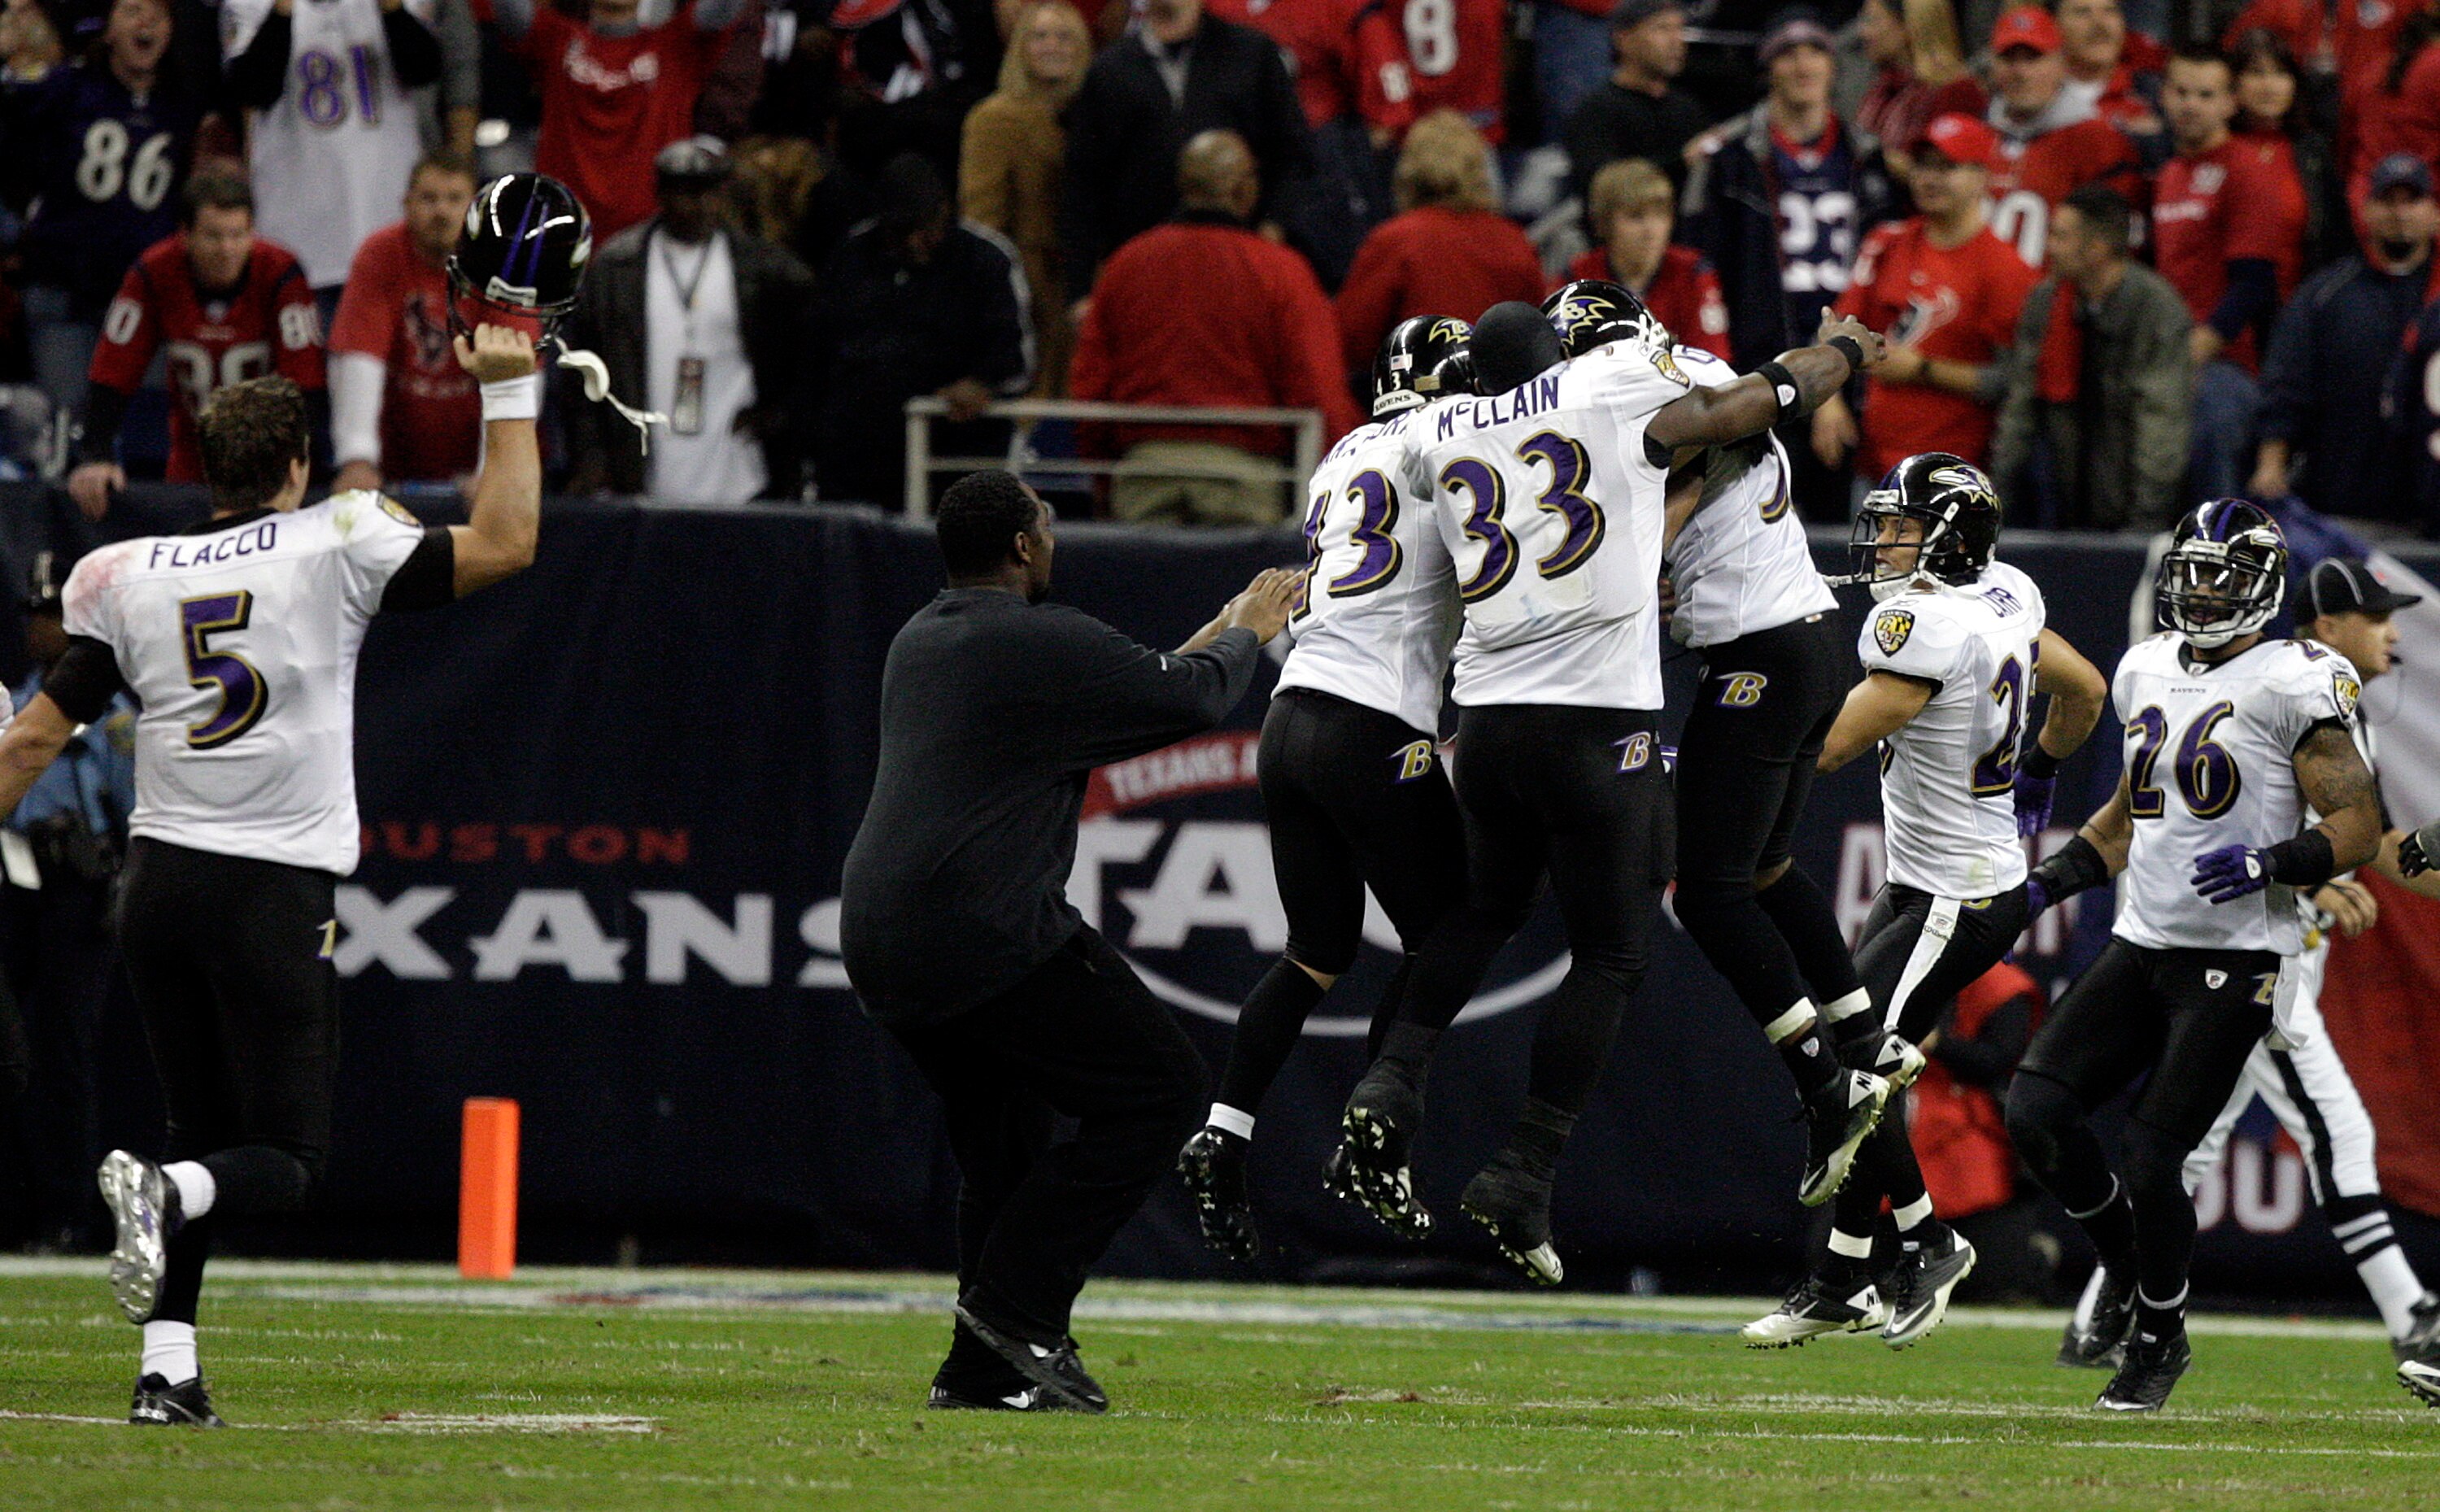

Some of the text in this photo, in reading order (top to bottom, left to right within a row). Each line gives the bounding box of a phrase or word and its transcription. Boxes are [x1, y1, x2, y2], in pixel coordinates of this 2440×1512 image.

[296, 43, 382, 131] 81
[75, 117, 175, 212] 86
[150, 521, 277, 569] FLACCO
[1438, 429, 1606, 604] 33
[179, 589, 269, 751] 5
[2125, 700, 2242, 821] 26
[359, 821, 690, 864] USTON
